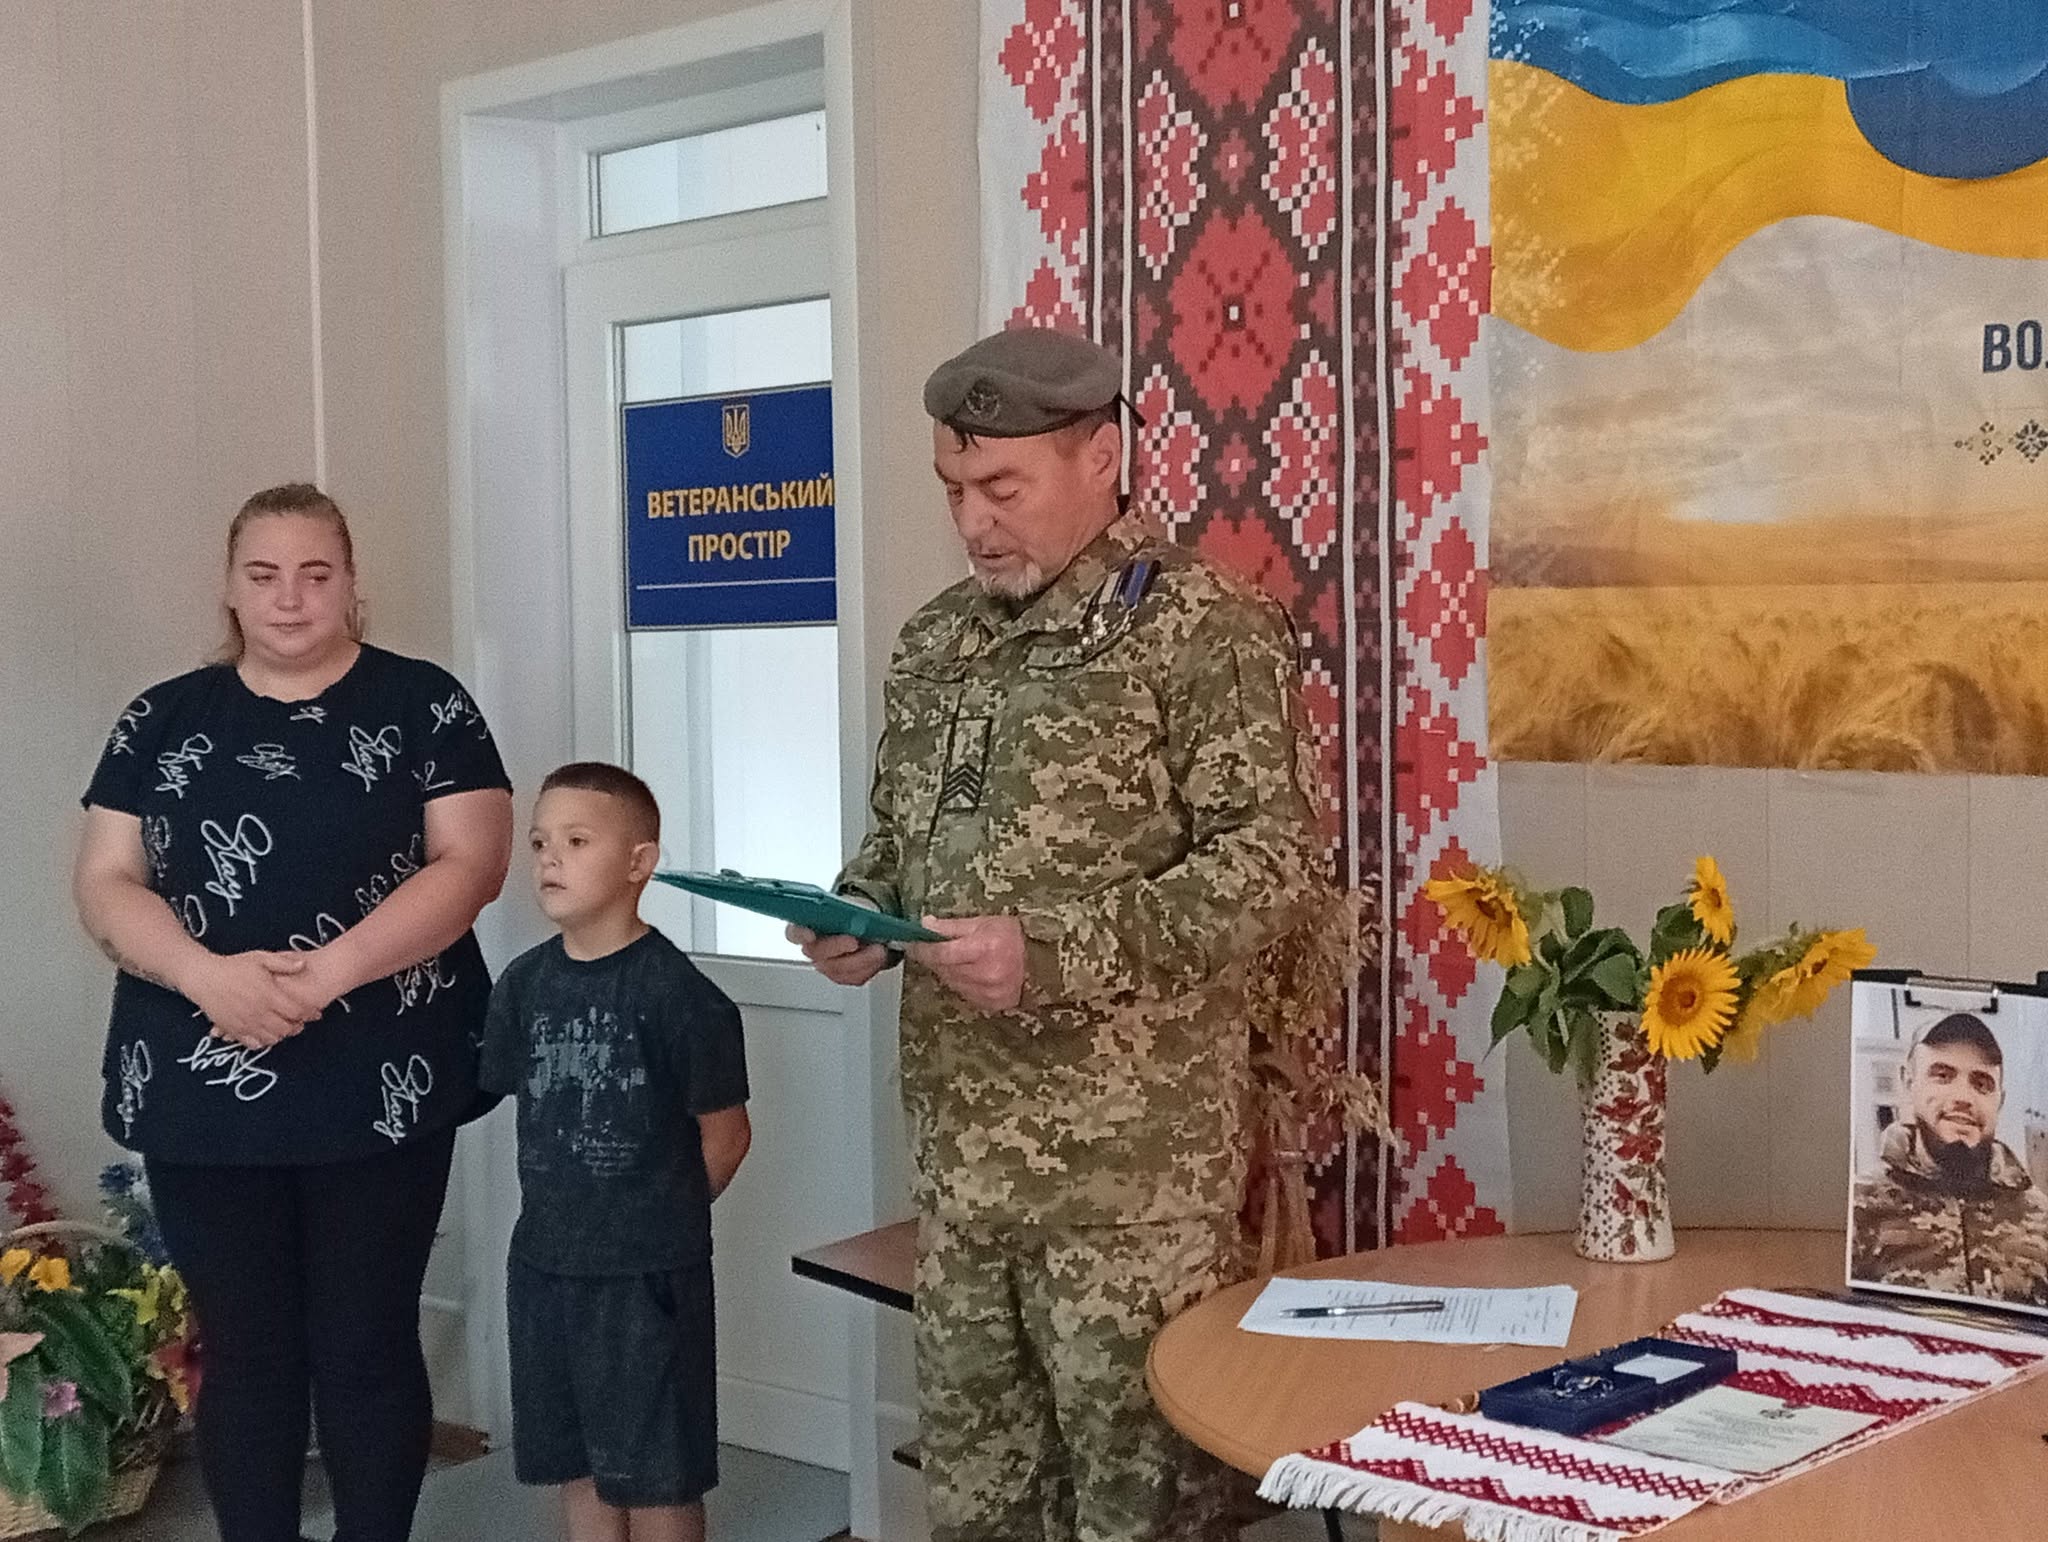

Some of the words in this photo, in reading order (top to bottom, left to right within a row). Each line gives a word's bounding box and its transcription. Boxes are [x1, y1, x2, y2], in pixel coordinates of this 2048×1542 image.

[1982, 319, 2048, 374] ВО
[647, 472, 835, 519] ВЕТЕРАНСЬКИЙ
[688, 529, 791, 562] ПРОСТІР
[200, 814, 273, 917] Stay
[373, 1054, 433, 1145] Stay
